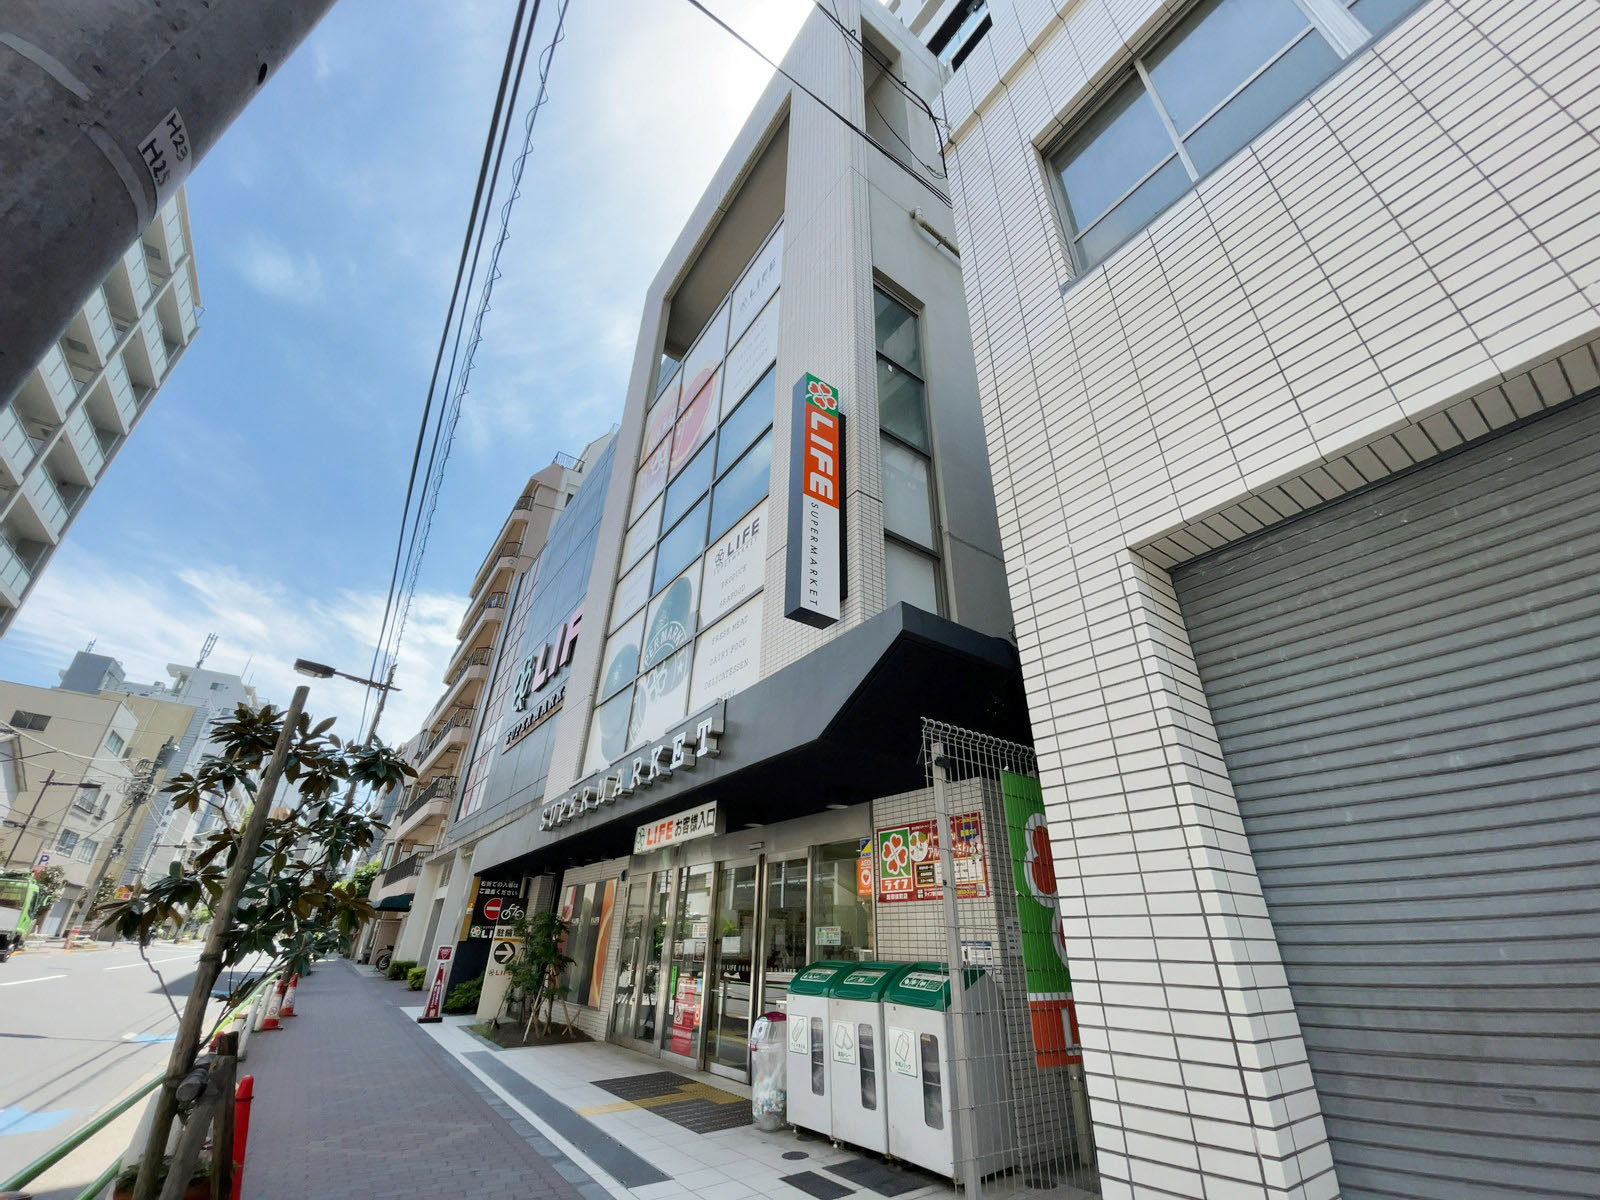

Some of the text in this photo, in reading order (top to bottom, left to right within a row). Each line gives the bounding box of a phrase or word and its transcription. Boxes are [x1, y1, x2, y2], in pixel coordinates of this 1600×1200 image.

[167, 114, 188, 162] H23
[810, 411, 834, 500] LIFE
[728, 518, 759, 556] LIFE
[809, 502, 819, 606] SUPERMARKET
[539, 717, 713, 832] SUPERMARKET
[646, 808, 716, 846] LIFE お客様入口
[884, 879, 909, 891] ライフ
